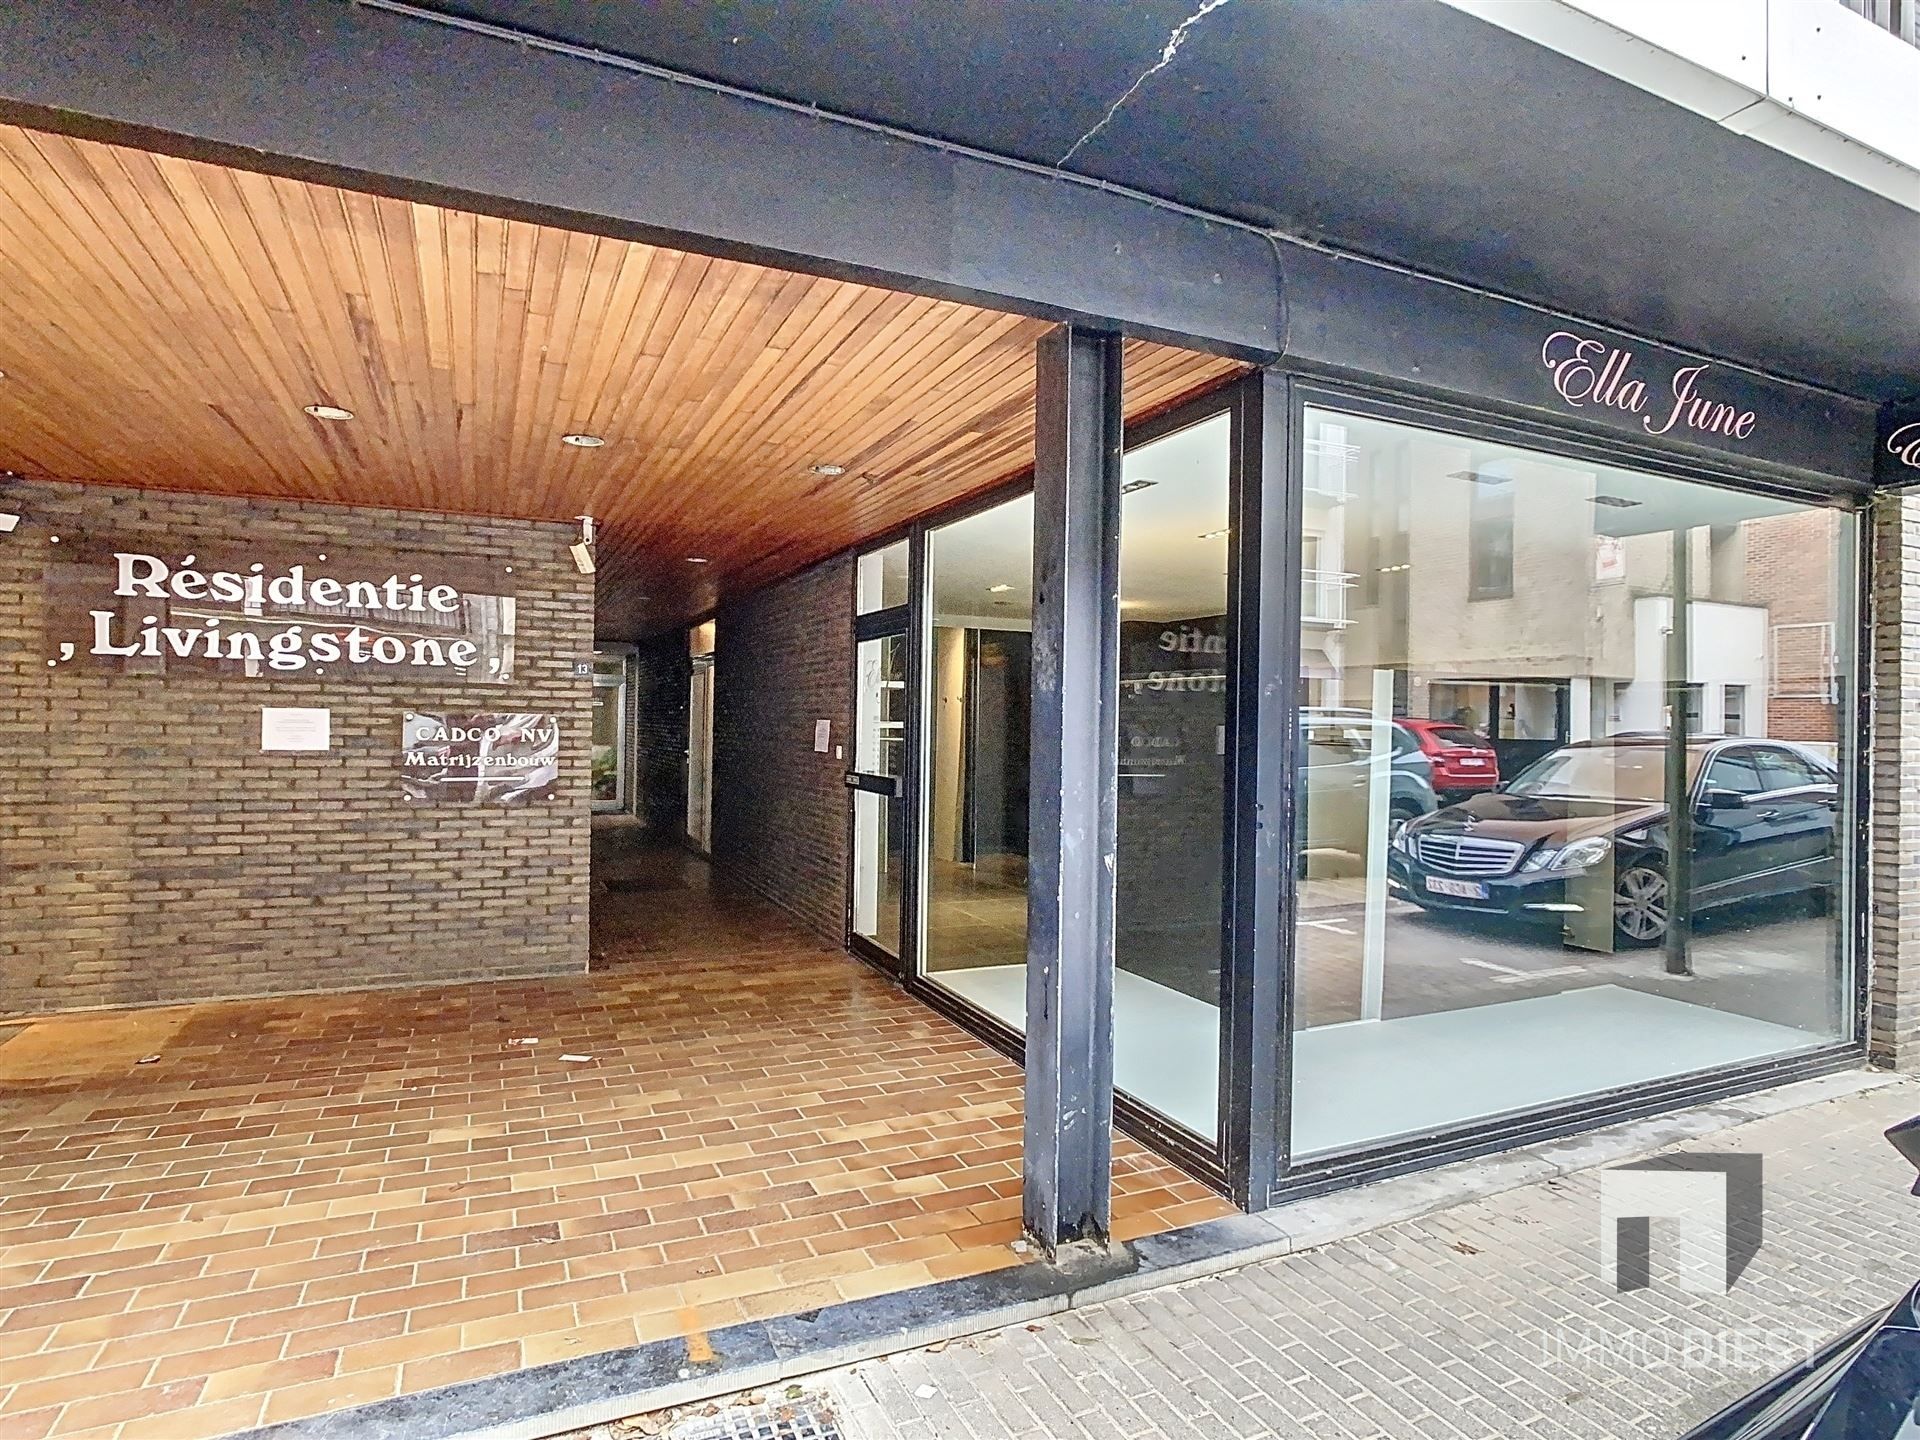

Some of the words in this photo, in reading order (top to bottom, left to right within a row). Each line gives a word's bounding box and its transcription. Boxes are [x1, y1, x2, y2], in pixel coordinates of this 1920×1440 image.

[1541, 331, 1647, 413] Ella
[1643, 364, 1756, 440] June
[113, 553, 460, 613] Résidentie
[577, 664, 588, 674] 13
[416, 726, 501, 742] CADCO
[520, 728, 553, 743] NV
[404, 751, 556, 768] Matrijzenbouw
